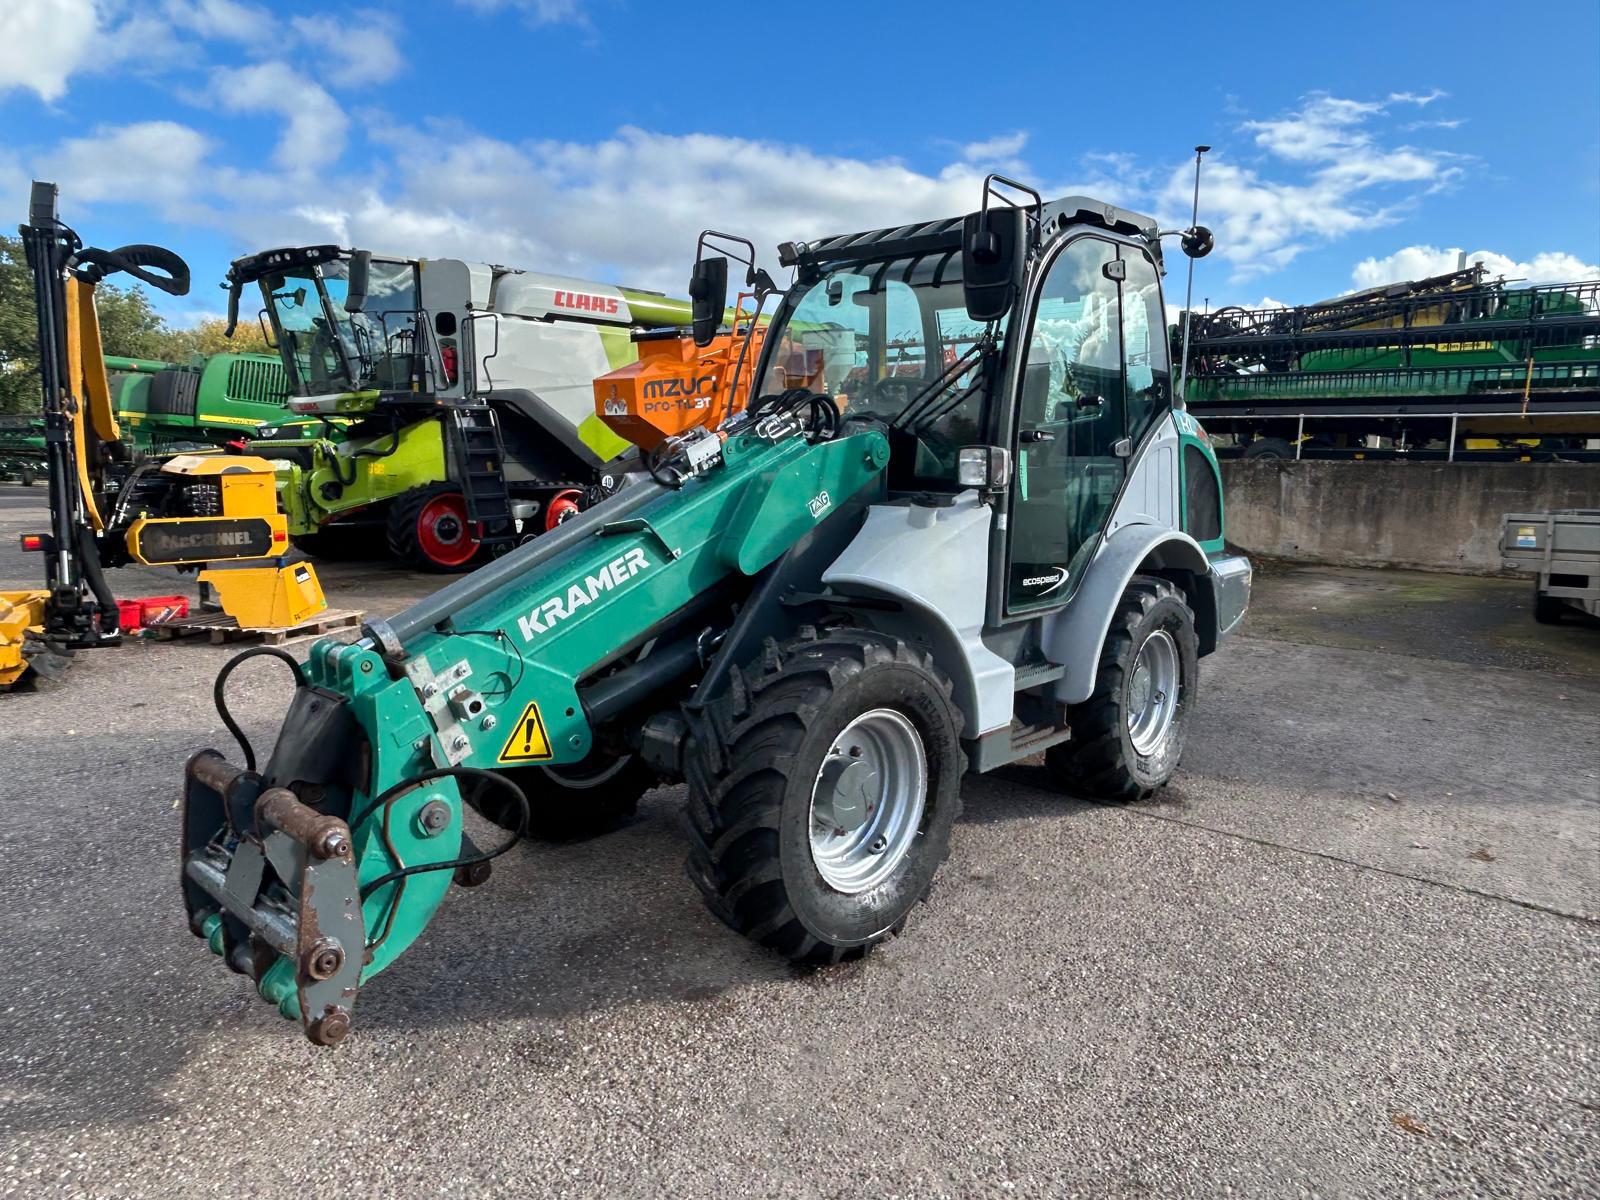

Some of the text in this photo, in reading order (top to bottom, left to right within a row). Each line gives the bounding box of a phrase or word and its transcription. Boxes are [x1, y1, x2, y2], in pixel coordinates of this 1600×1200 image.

[554, 291, 619, 314] CLAAS
[1022, 574, 1060, 586] ecospeed
[517, 547, 651, 642] KRAMER
